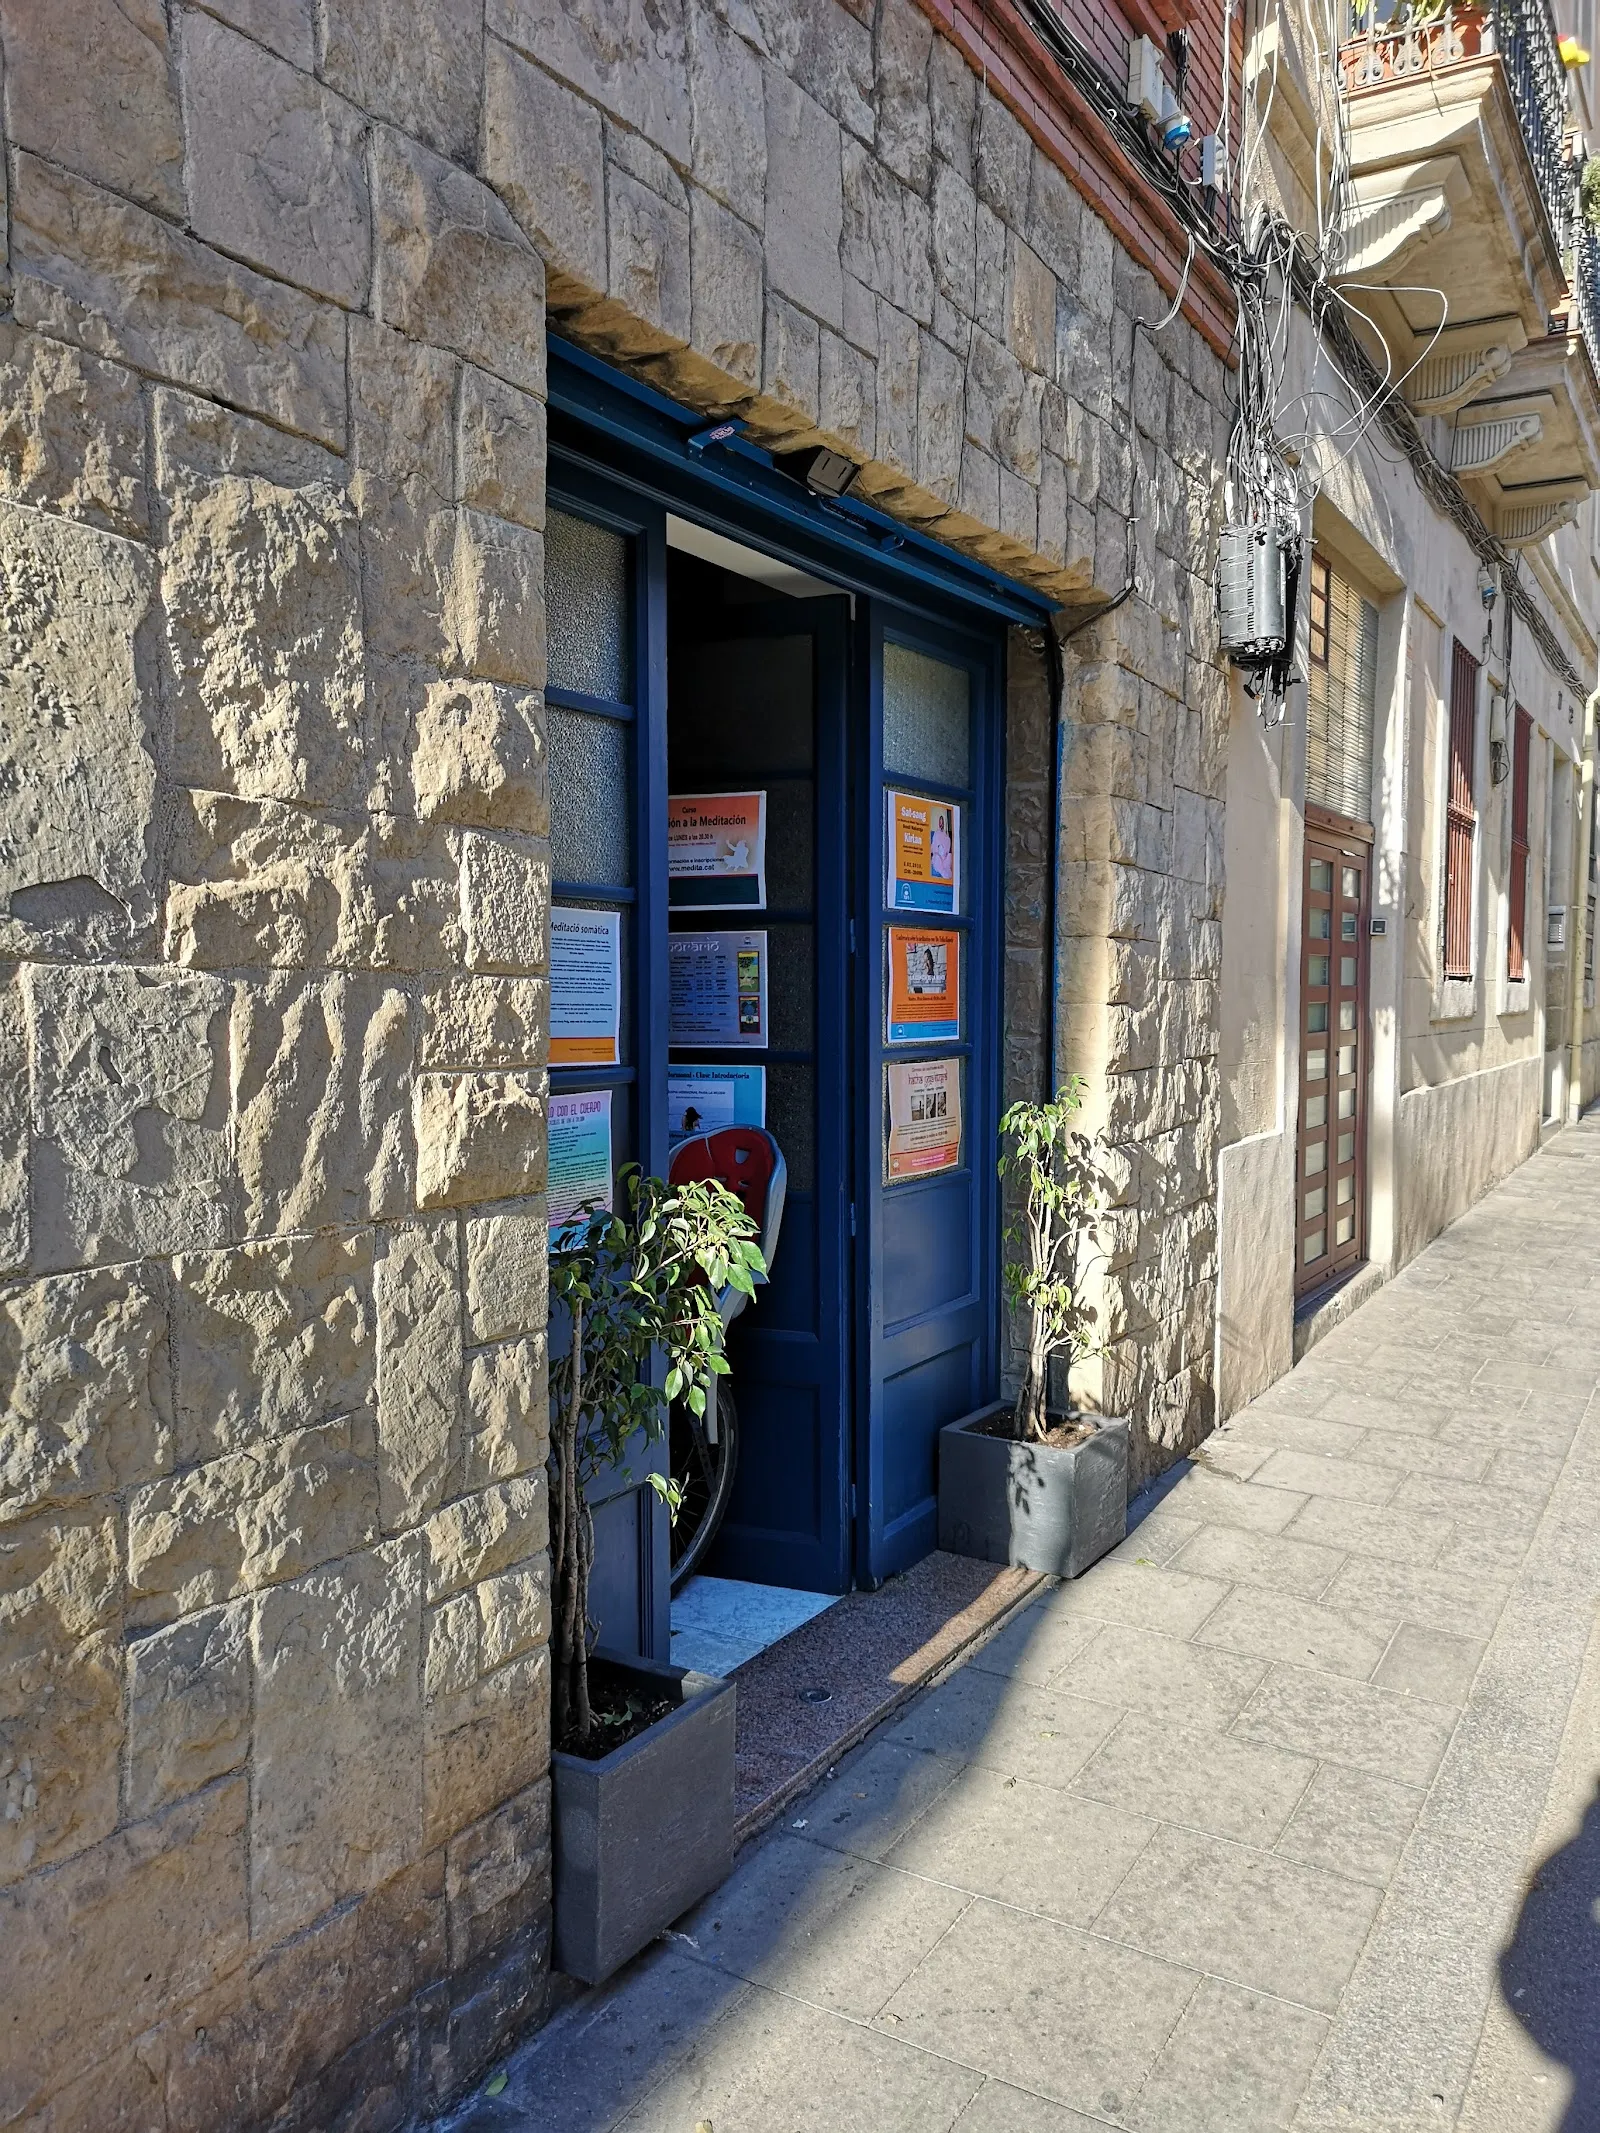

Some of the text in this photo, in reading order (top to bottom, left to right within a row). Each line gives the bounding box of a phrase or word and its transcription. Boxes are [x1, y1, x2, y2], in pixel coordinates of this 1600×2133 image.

[690, 817, 697, 827] la
[700, 815, 746, 827] Meditación
[580, 1100, 601, 1114] CUERPO
